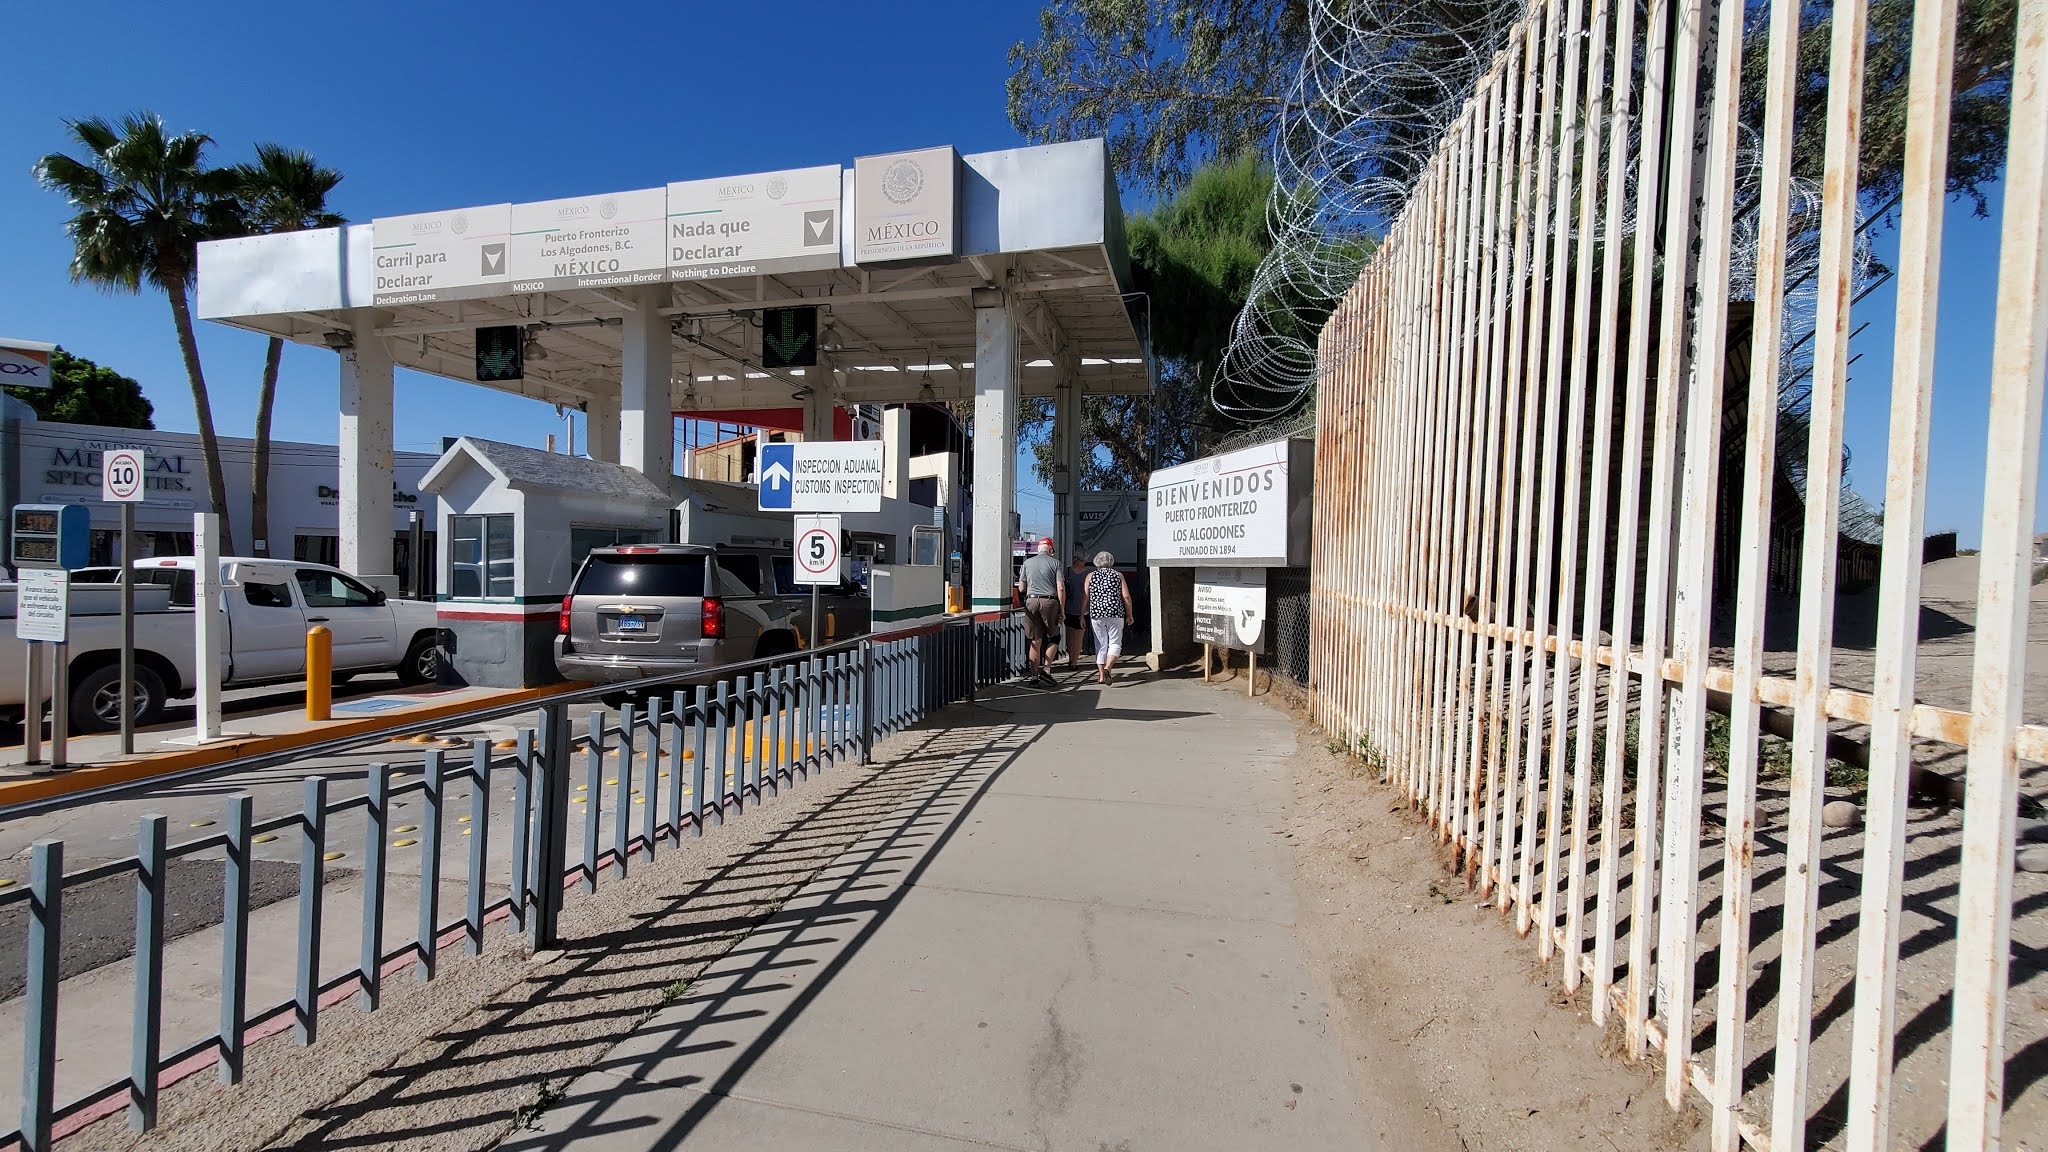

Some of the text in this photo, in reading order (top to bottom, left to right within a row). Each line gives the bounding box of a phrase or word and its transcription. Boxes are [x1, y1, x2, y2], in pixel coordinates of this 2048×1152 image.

[545, 226, 630, 243] Puerto Fronterizo
[672, 221, 750, 238] Nada que
[867, 221, 939, 241] MÉXICO
[541, 240, 634, 258] Los Algodones, B.C.
[672, 244, 743, 261] Declarar
[376, 252, 447, 268] Carril para
[554, 258, 620, 277] MÉXICO
[671, 264, 757, 279] Nothing to Declare
[376, 274, 433, 289] Declarar
[513, 273, 663, 292] MEXICO International Border
[376, 293, 437, 305] Declaration Lane
[795, 459, 881, 474] INSPECCION ADUANAL
[113, 467, 134, 485] 10
[794, 479, 880, 494] CUSTOMS INSPECTION
[1156, 470, 1273, 507] BIENVENIDOS
[1165, 499, 1258, 524] PUERTO FRONTERIZO
[1173, 524, 1245, 542] LOS ALGODONES
[810, 535, 825, 559] 5
[1179, 545, 1236, 556] FUNDADO EN 1894
[25, 586, 58, 594] Avance hasta
[27, 602, 48, 610] enfrente
[48, 604, 62, 612] salga
